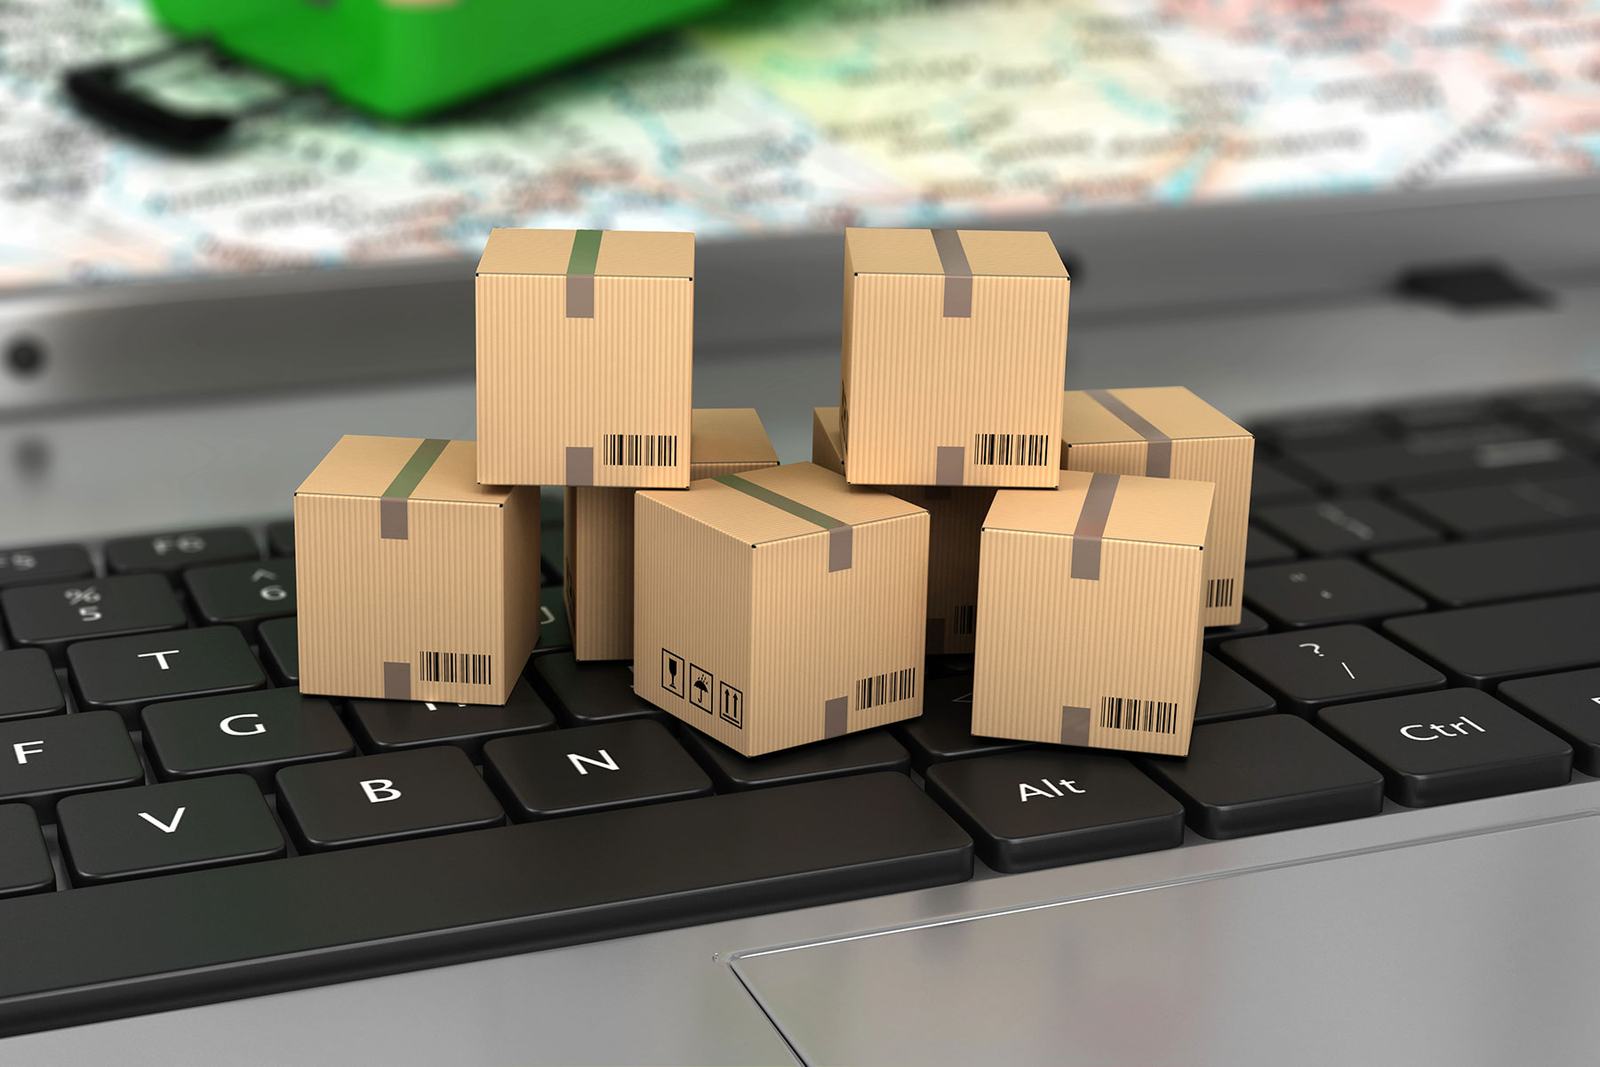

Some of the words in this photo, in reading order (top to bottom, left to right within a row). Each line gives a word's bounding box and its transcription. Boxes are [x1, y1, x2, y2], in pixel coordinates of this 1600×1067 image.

[79, 605, 102, 621] 5
[137, 649, 180, 670] T
[219, 713, 267, 736] G
[1399, 716, 1486, 741] Ctrl
[13, 740, 44, 764] F
[566, 749, 620, 775] N
[359, 779, 402, 803] B
[1018, 778, 1086, 802] Alt
[137, 806, 186, 833] V
